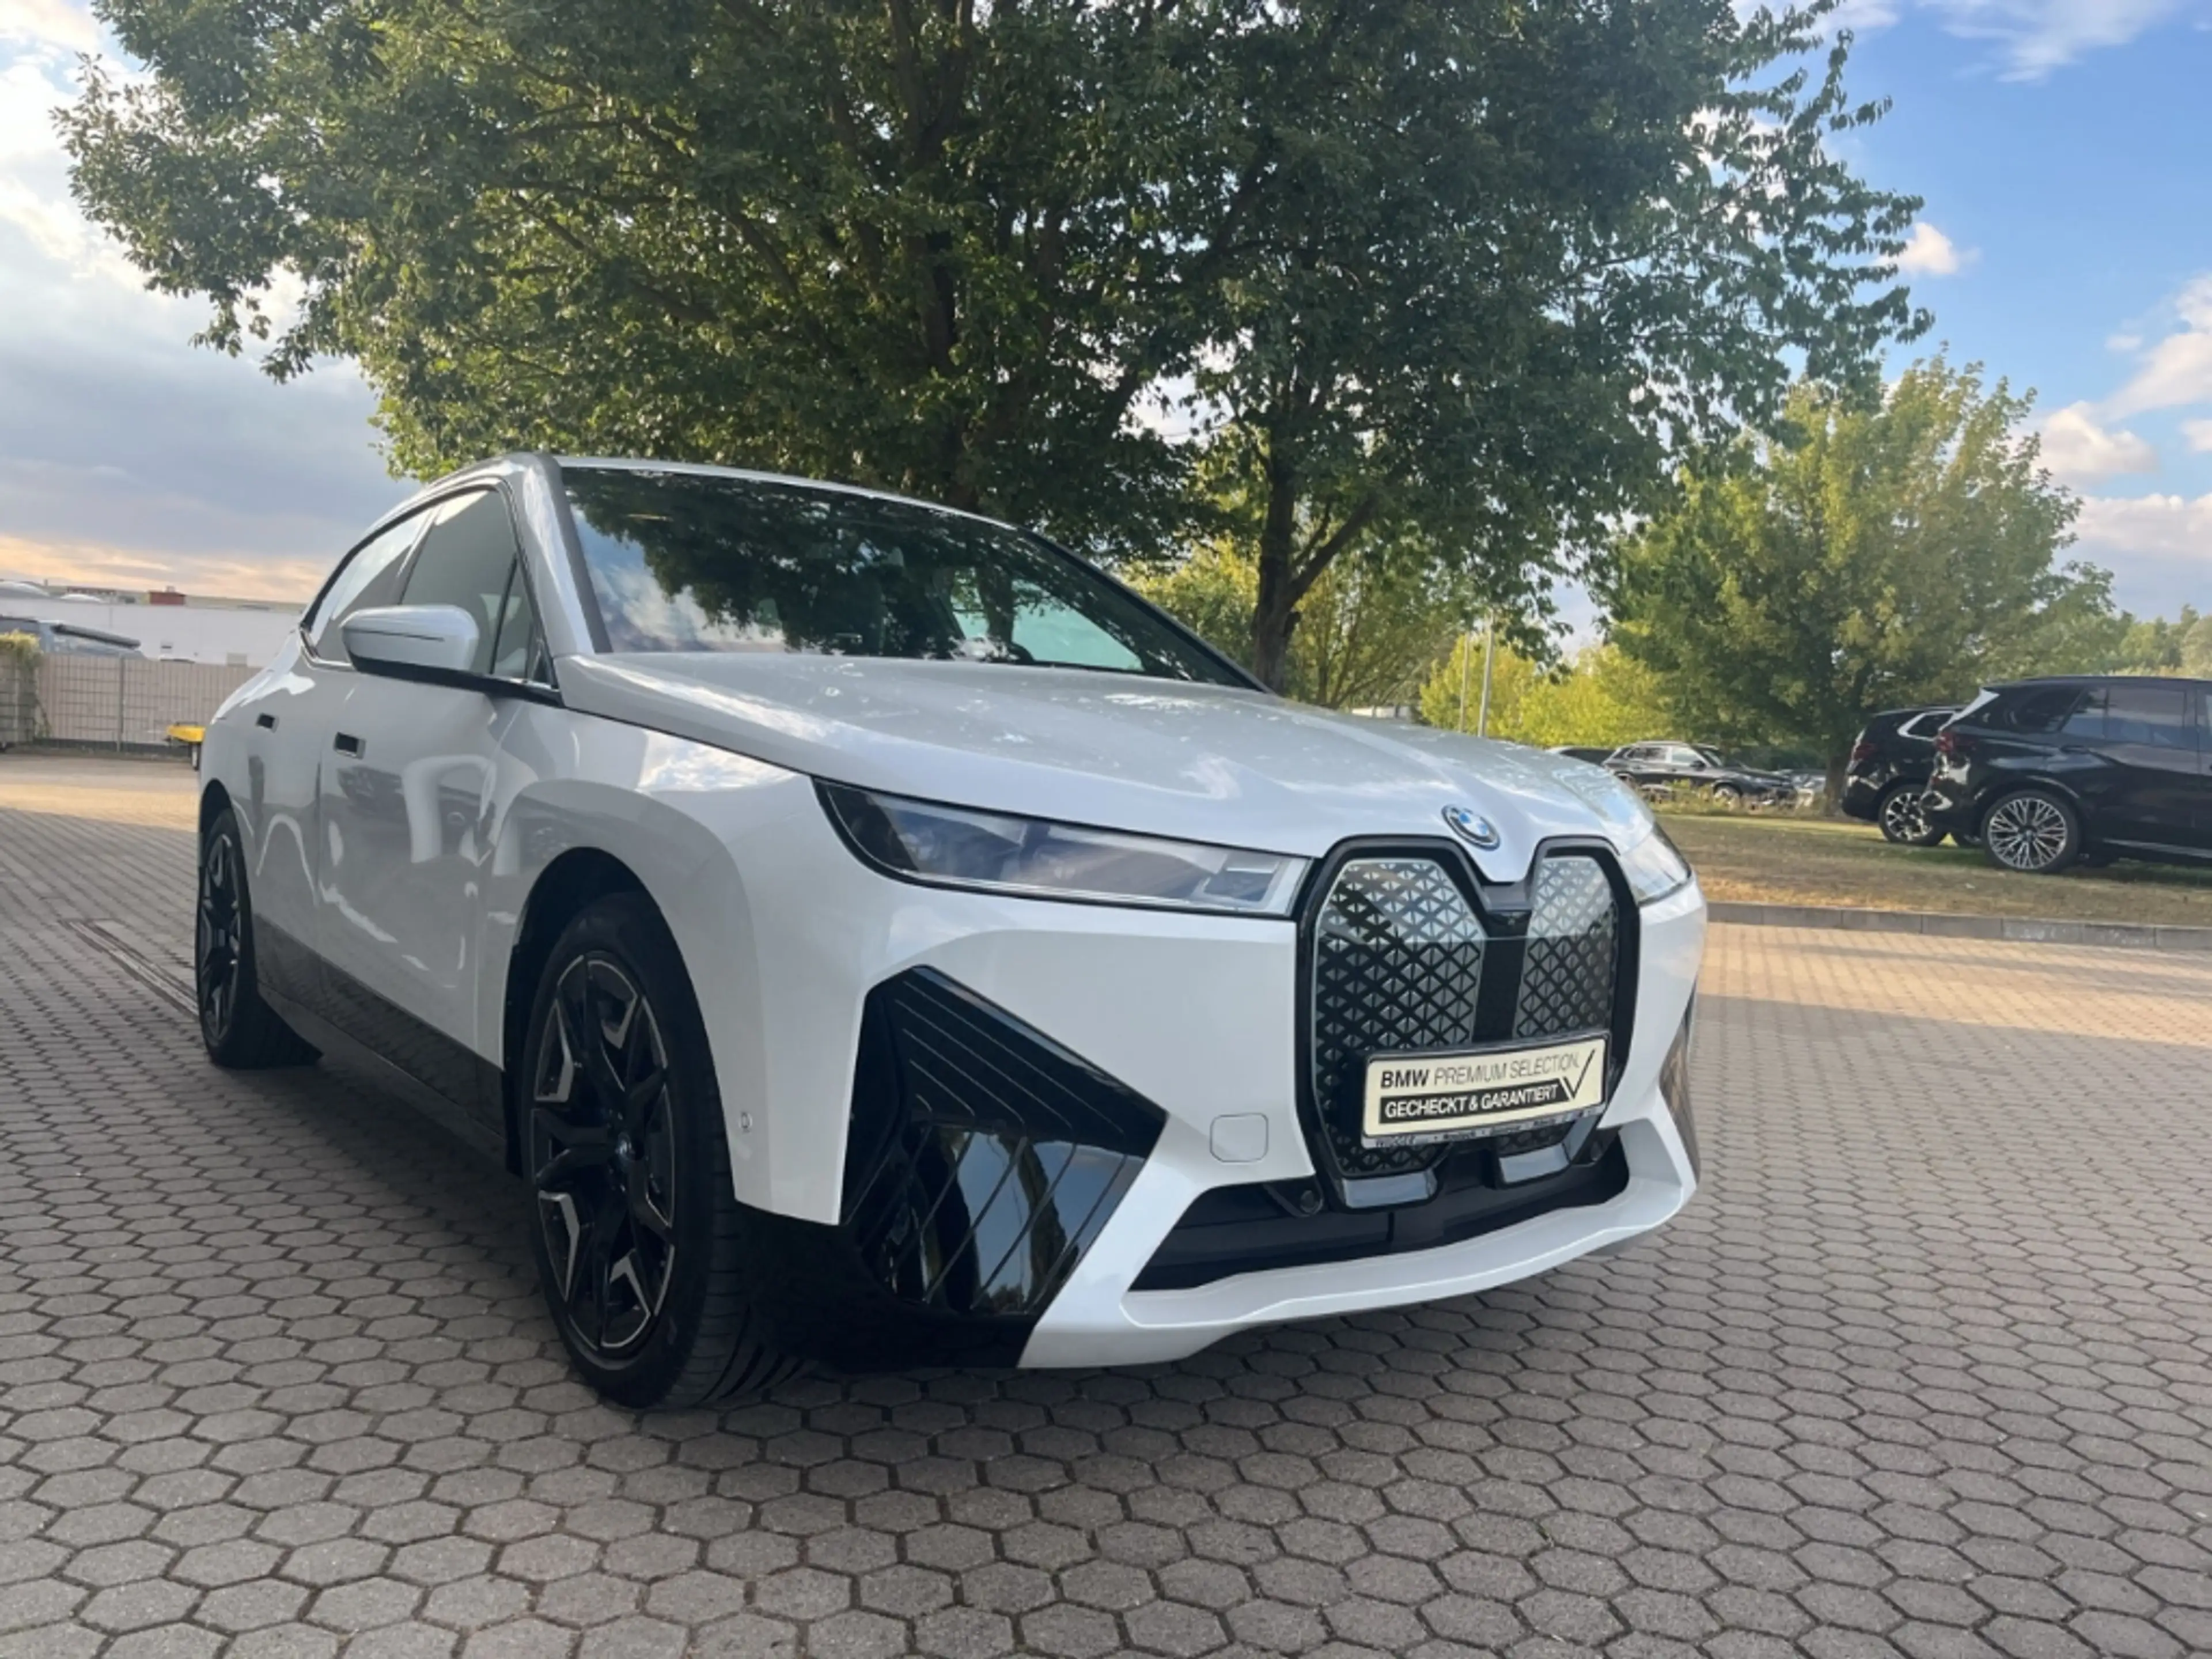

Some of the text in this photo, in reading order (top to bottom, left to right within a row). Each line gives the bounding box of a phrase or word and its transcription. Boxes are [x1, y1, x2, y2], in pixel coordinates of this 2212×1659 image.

[1381, 1053, 1580, 1089] BMW PREMIUM SELECTION
[1384, 1084, 1558, 1118] GECHECKT & GARANTIERT
